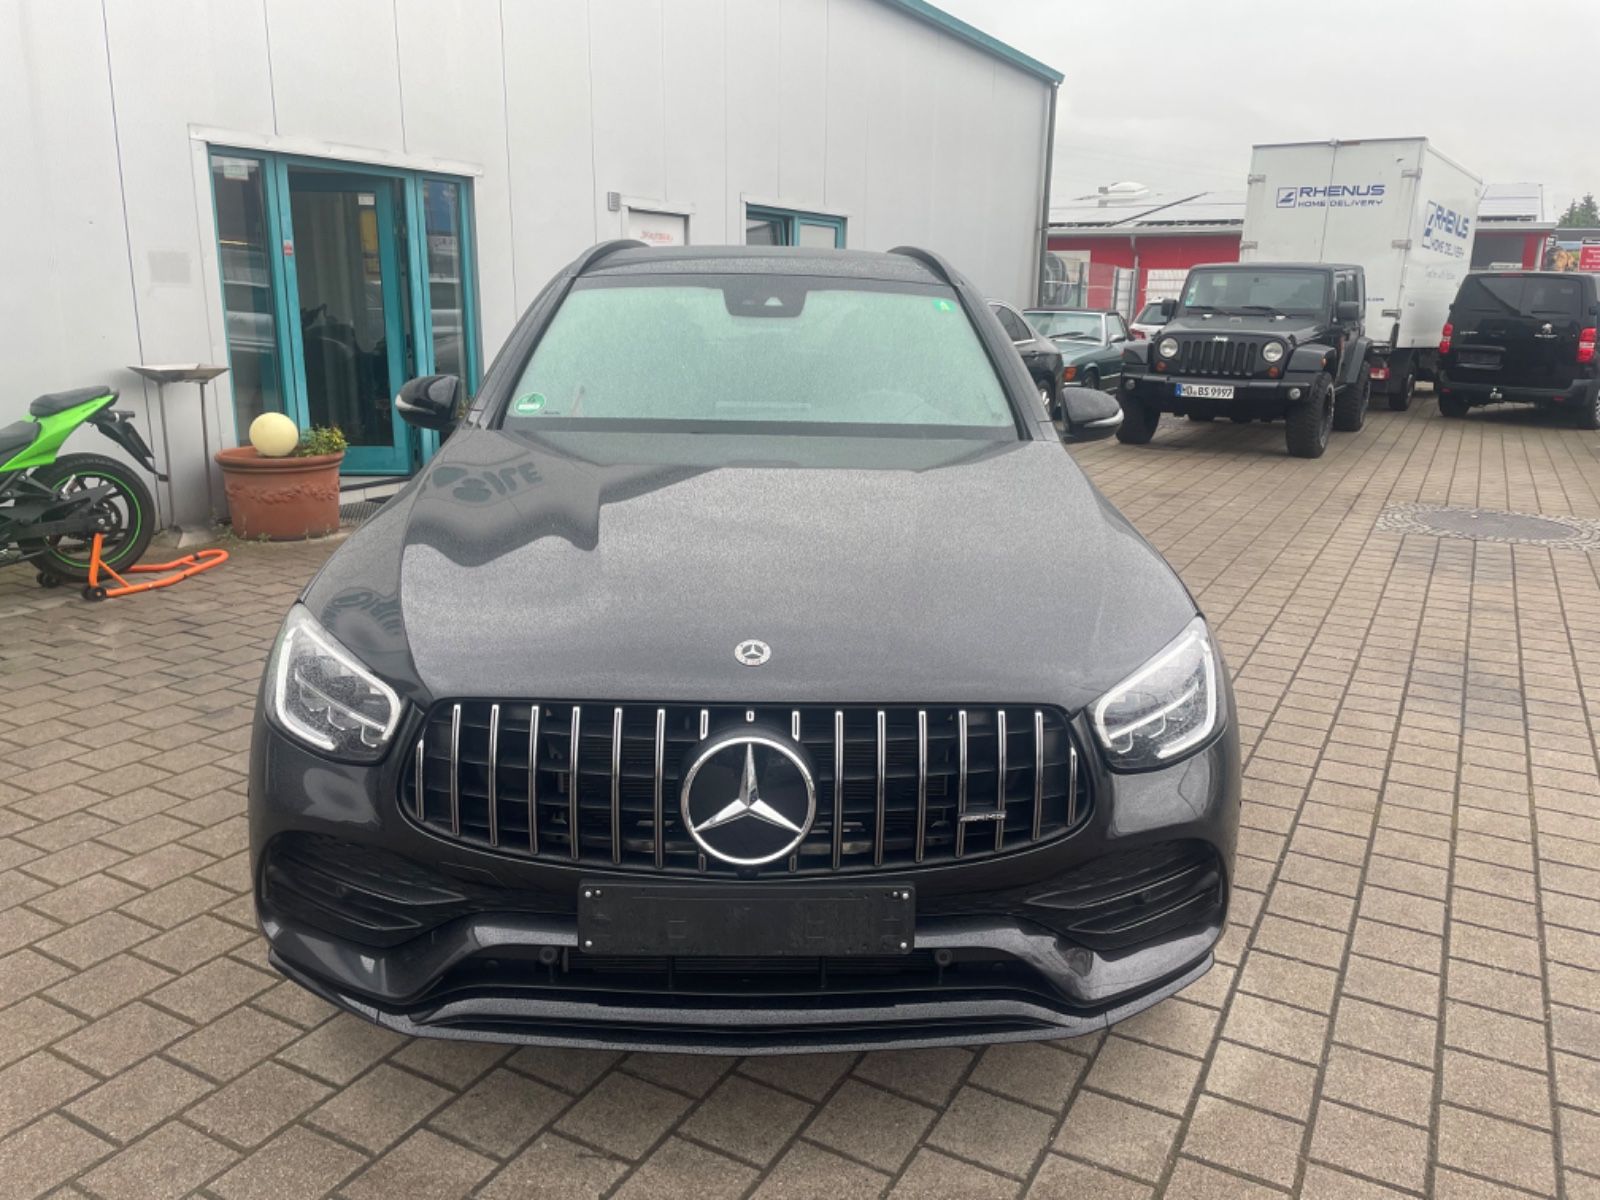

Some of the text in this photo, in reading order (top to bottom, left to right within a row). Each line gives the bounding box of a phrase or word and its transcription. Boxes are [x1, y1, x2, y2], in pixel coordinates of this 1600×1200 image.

[1300, 184, 1385, 197] RHENUS
[1330, 199, 1384, 208] DELIVERY
[1434, 204, 1469, 239] RHENUS
[1198, 387, 1209, 396] BS
